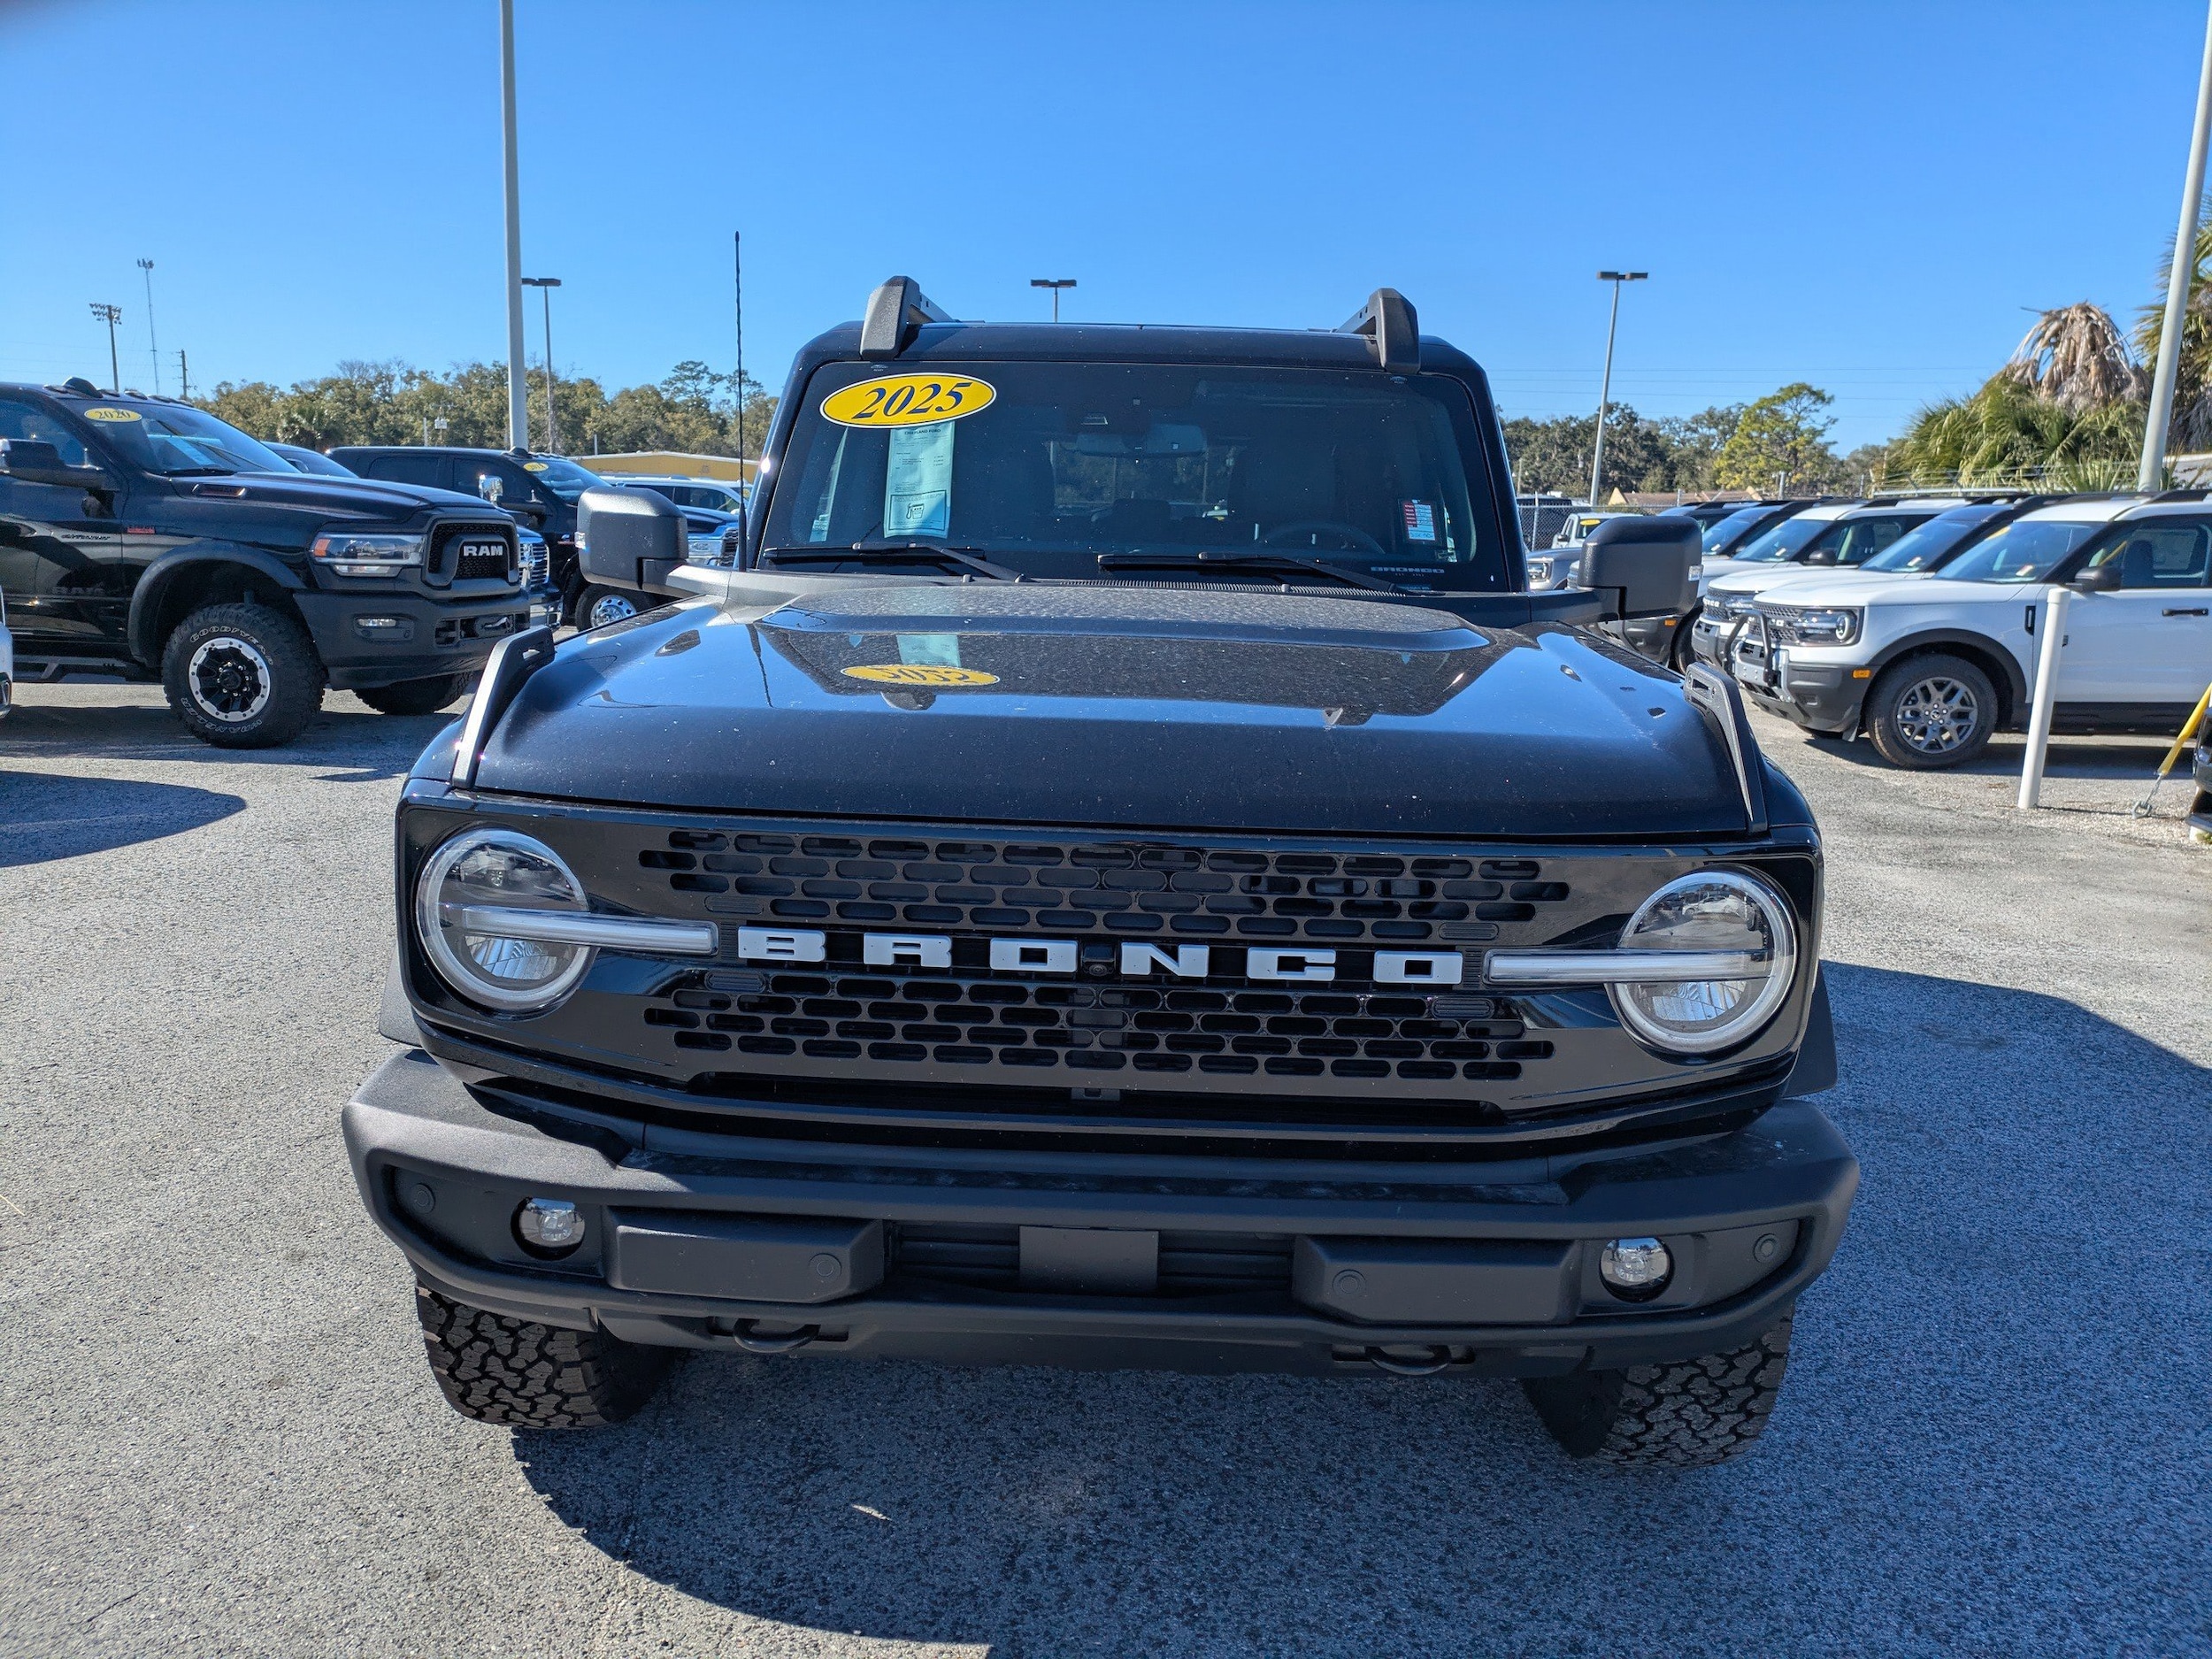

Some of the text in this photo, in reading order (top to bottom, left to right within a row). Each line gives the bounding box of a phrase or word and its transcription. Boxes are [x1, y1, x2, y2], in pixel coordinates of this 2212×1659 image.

[95, 411, 131, 419] 2020
[851, 381, 973, 419] 2025
[464, 545, 503, 557] RAM
[190, 626, 274, 665] GOODYEAR
[737, 926, 1463, 985] BRONCO
